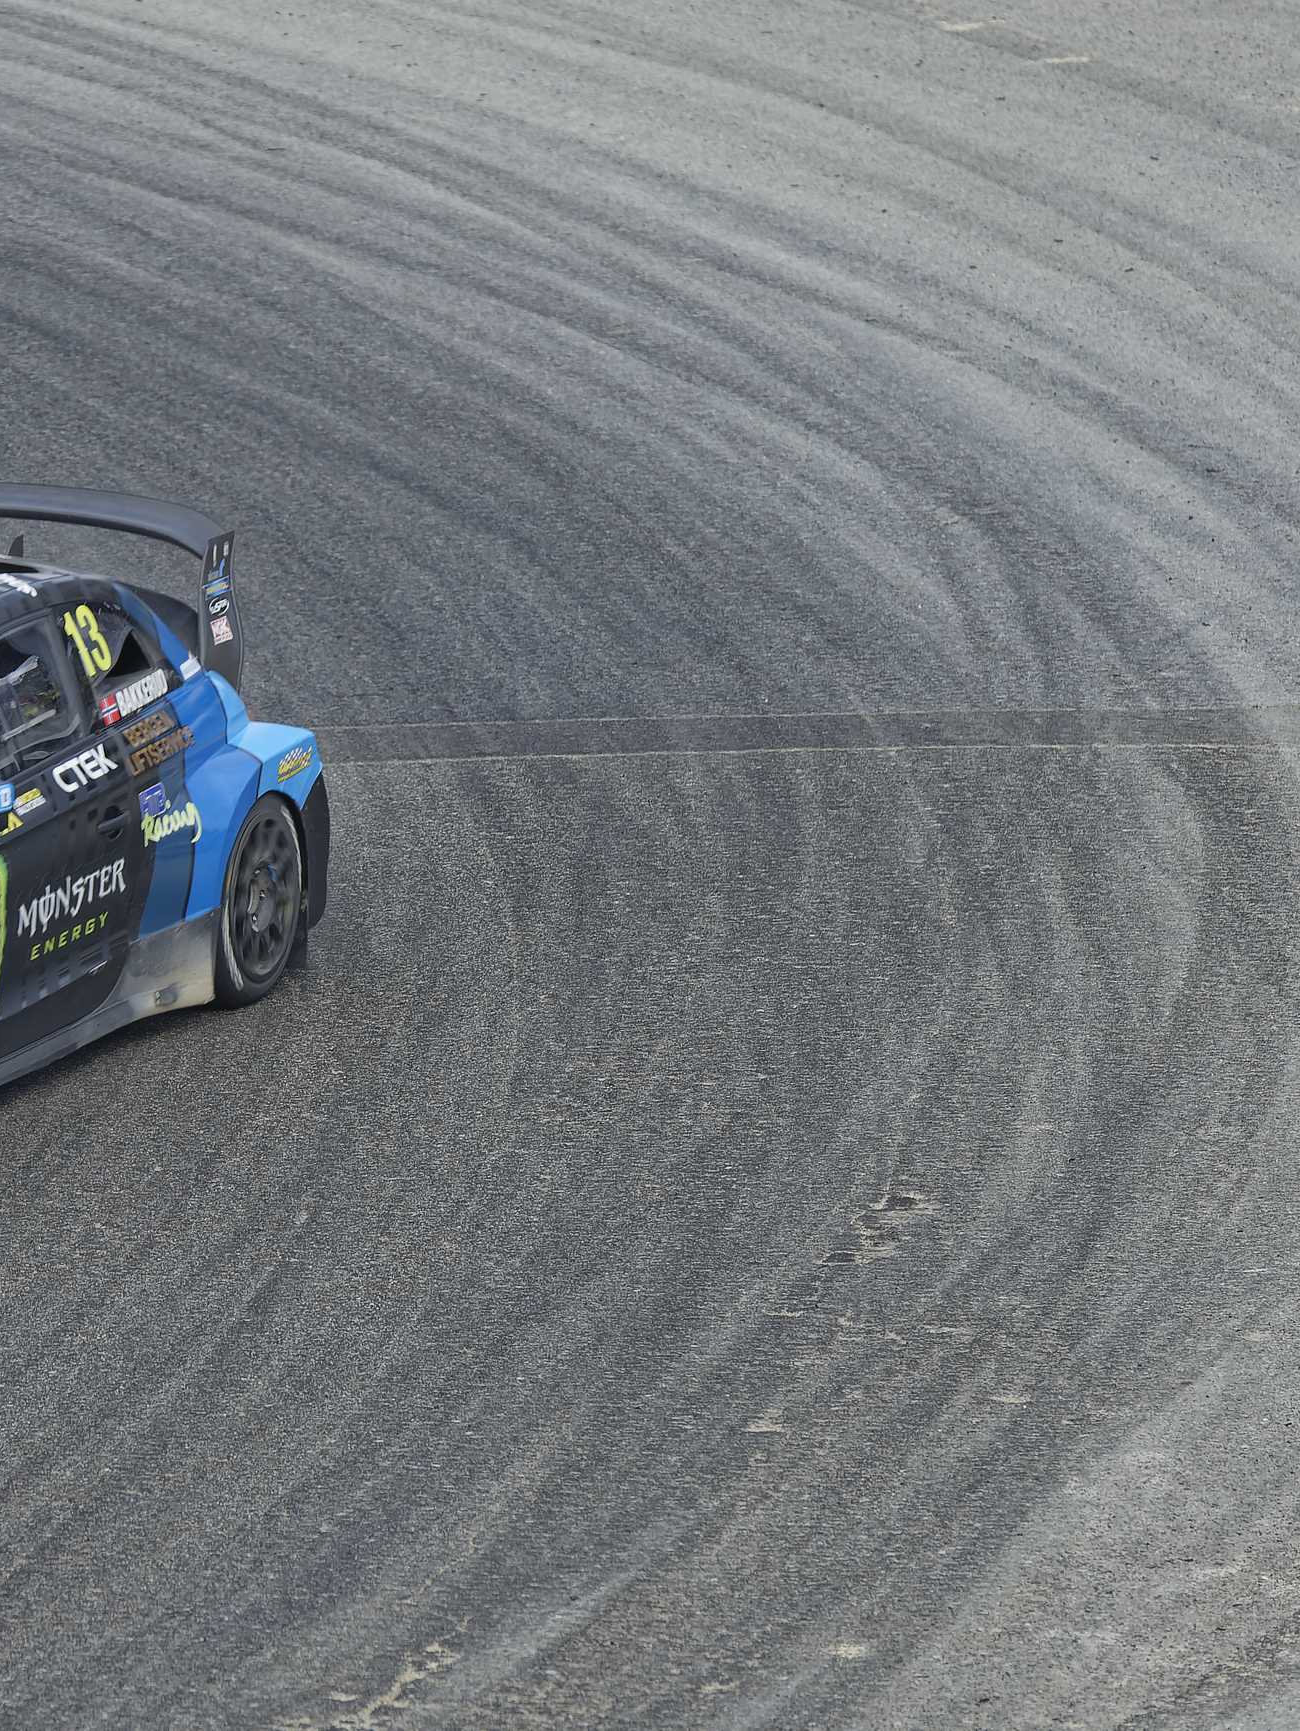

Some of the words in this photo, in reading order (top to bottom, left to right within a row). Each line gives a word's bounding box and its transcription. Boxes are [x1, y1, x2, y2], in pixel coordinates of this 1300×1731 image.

[63, 604, 113, 679] 13
[52, 743, 118, 793] CTEK
[17, 857, 126, 938] MONSTER
[30, 911, 109, 961] ENERGY
